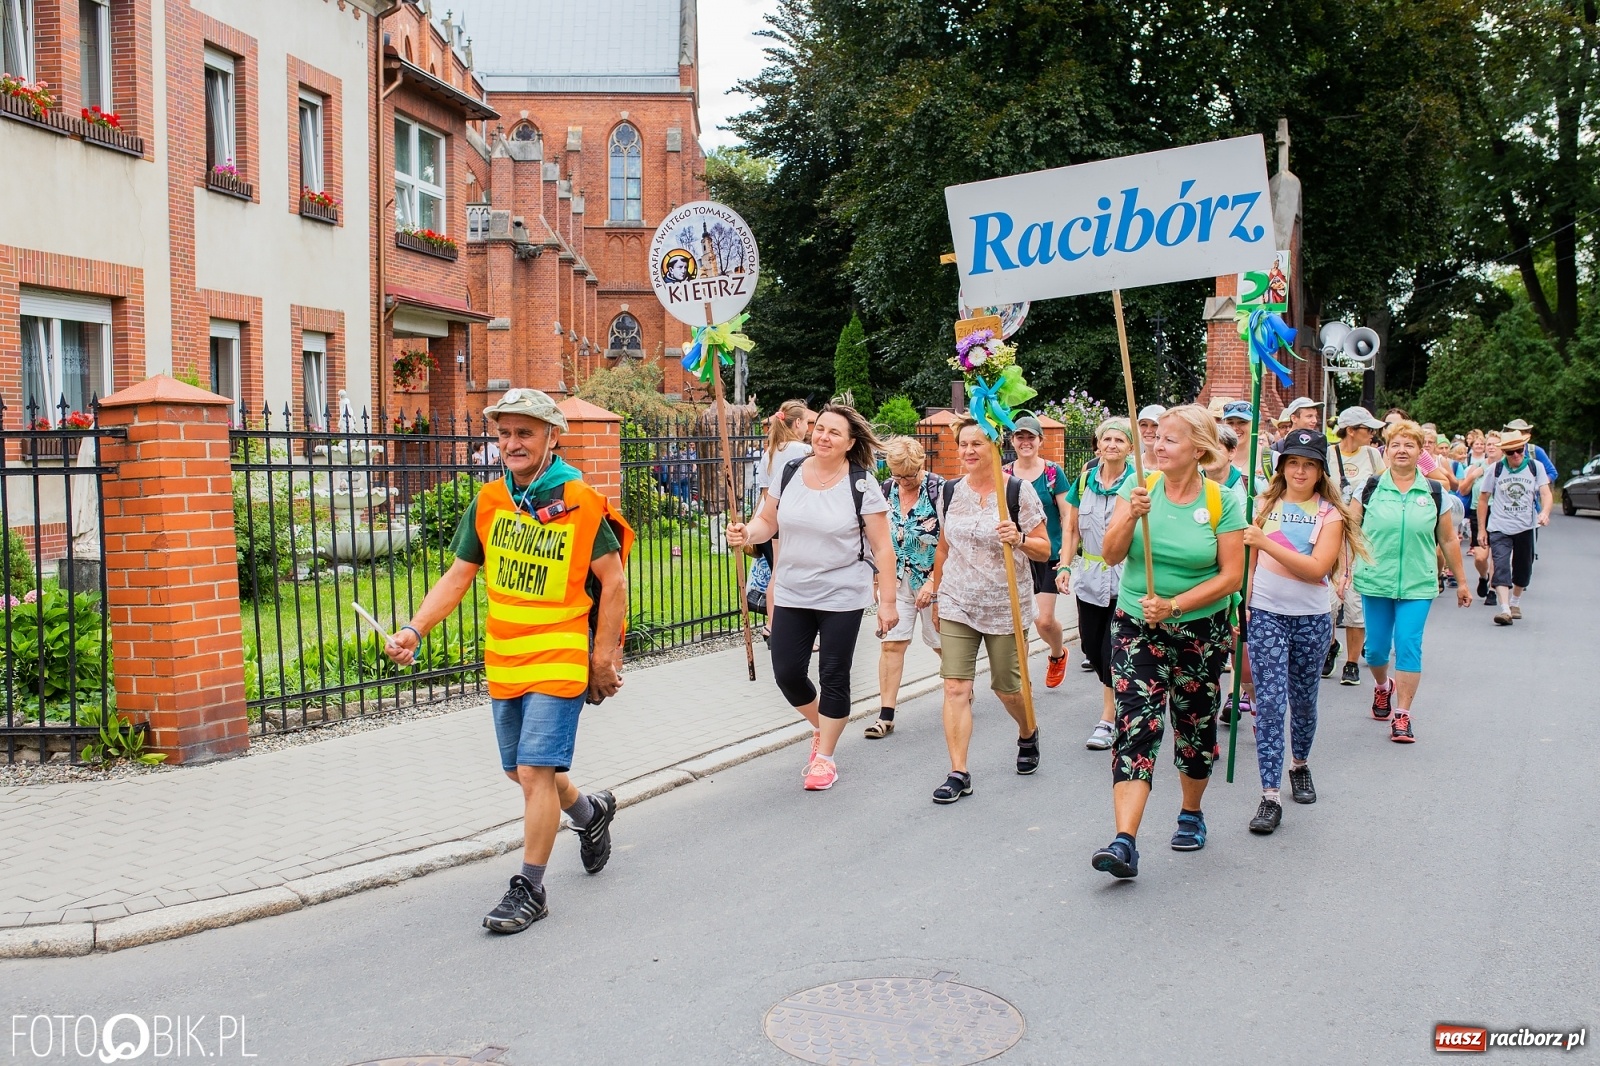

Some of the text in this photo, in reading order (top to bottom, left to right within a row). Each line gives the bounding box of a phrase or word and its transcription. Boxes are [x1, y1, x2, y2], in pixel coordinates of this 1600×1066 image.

[652, 206, 756, 289] PARAFIA ŚWIĘTEGO TOMASZA APOSTOŁA
[968, 179, 1265, 275] Racibórz
[668, 276, 747, 304] KIETRZ
[491, 517, 568, 561] KIEROWANIE
[1282, 513, 1317, 525] YEAH
[496, 555, 549, 596] RUCHEM
